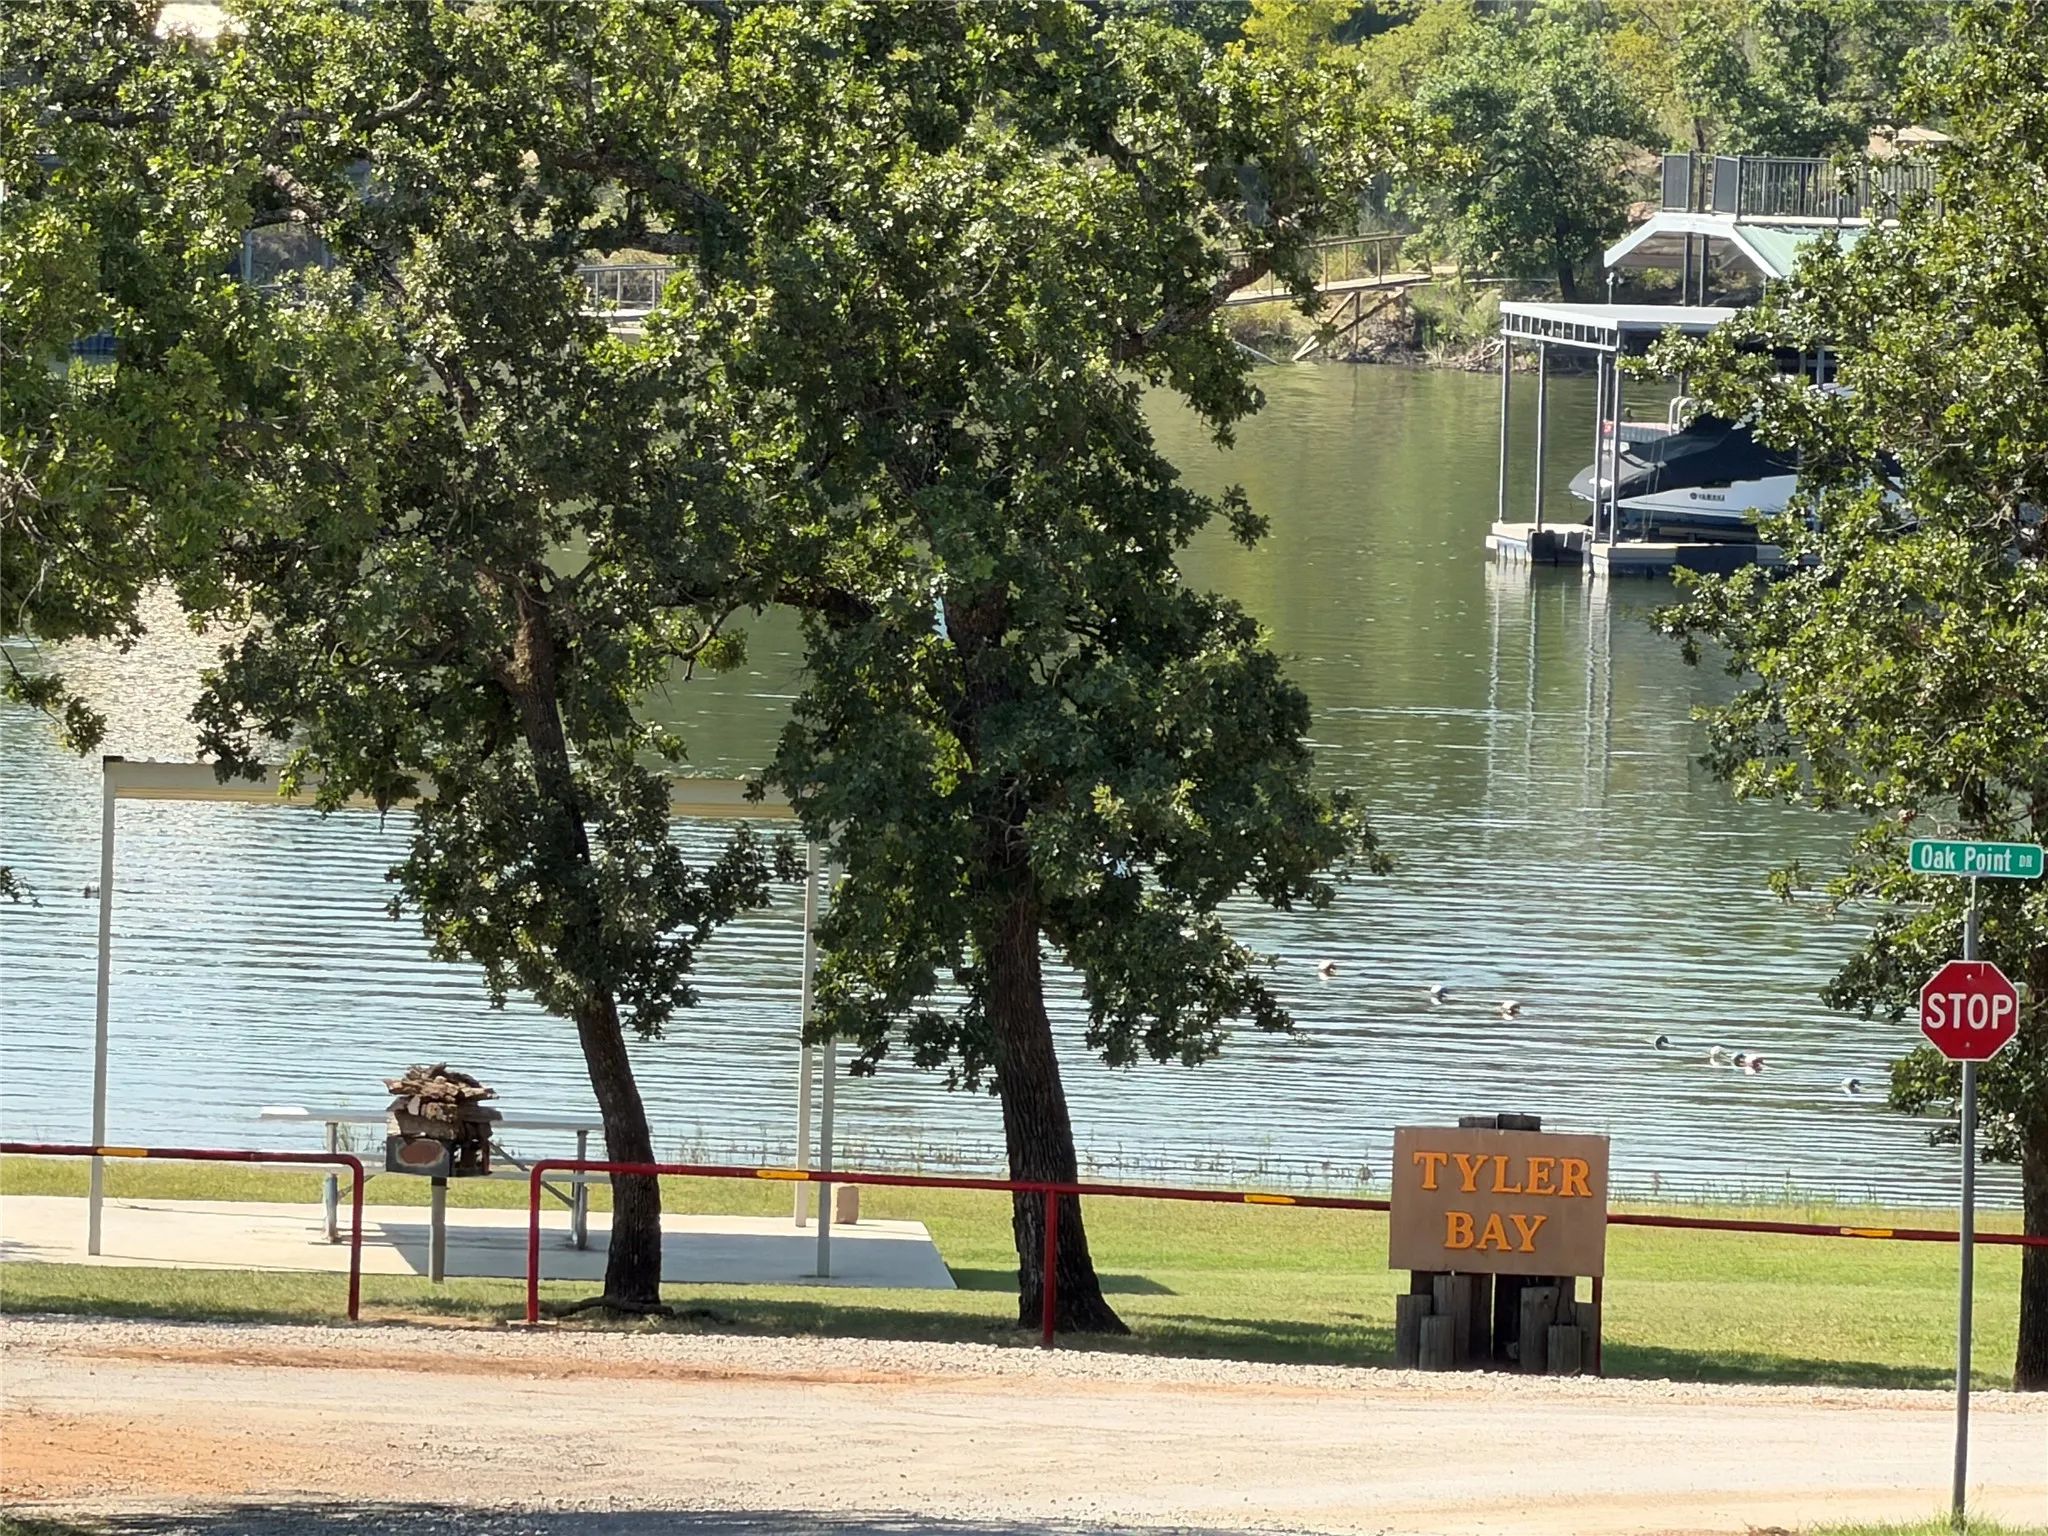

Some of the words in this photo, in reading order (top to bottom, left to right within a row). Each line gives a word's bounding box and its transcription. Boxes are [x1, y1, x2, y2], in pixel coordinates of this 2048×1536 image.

[1920, 844, 1956, 870] Oak
[1964, 846, 2013, 872] Point
[2018, 855, 2033, 868] DR
[1925, 992, 2014, 1030] STOP
[1412, 1151, 1593, 1197] TYLER
[1444, 1211, 1548, 1252] BAY
